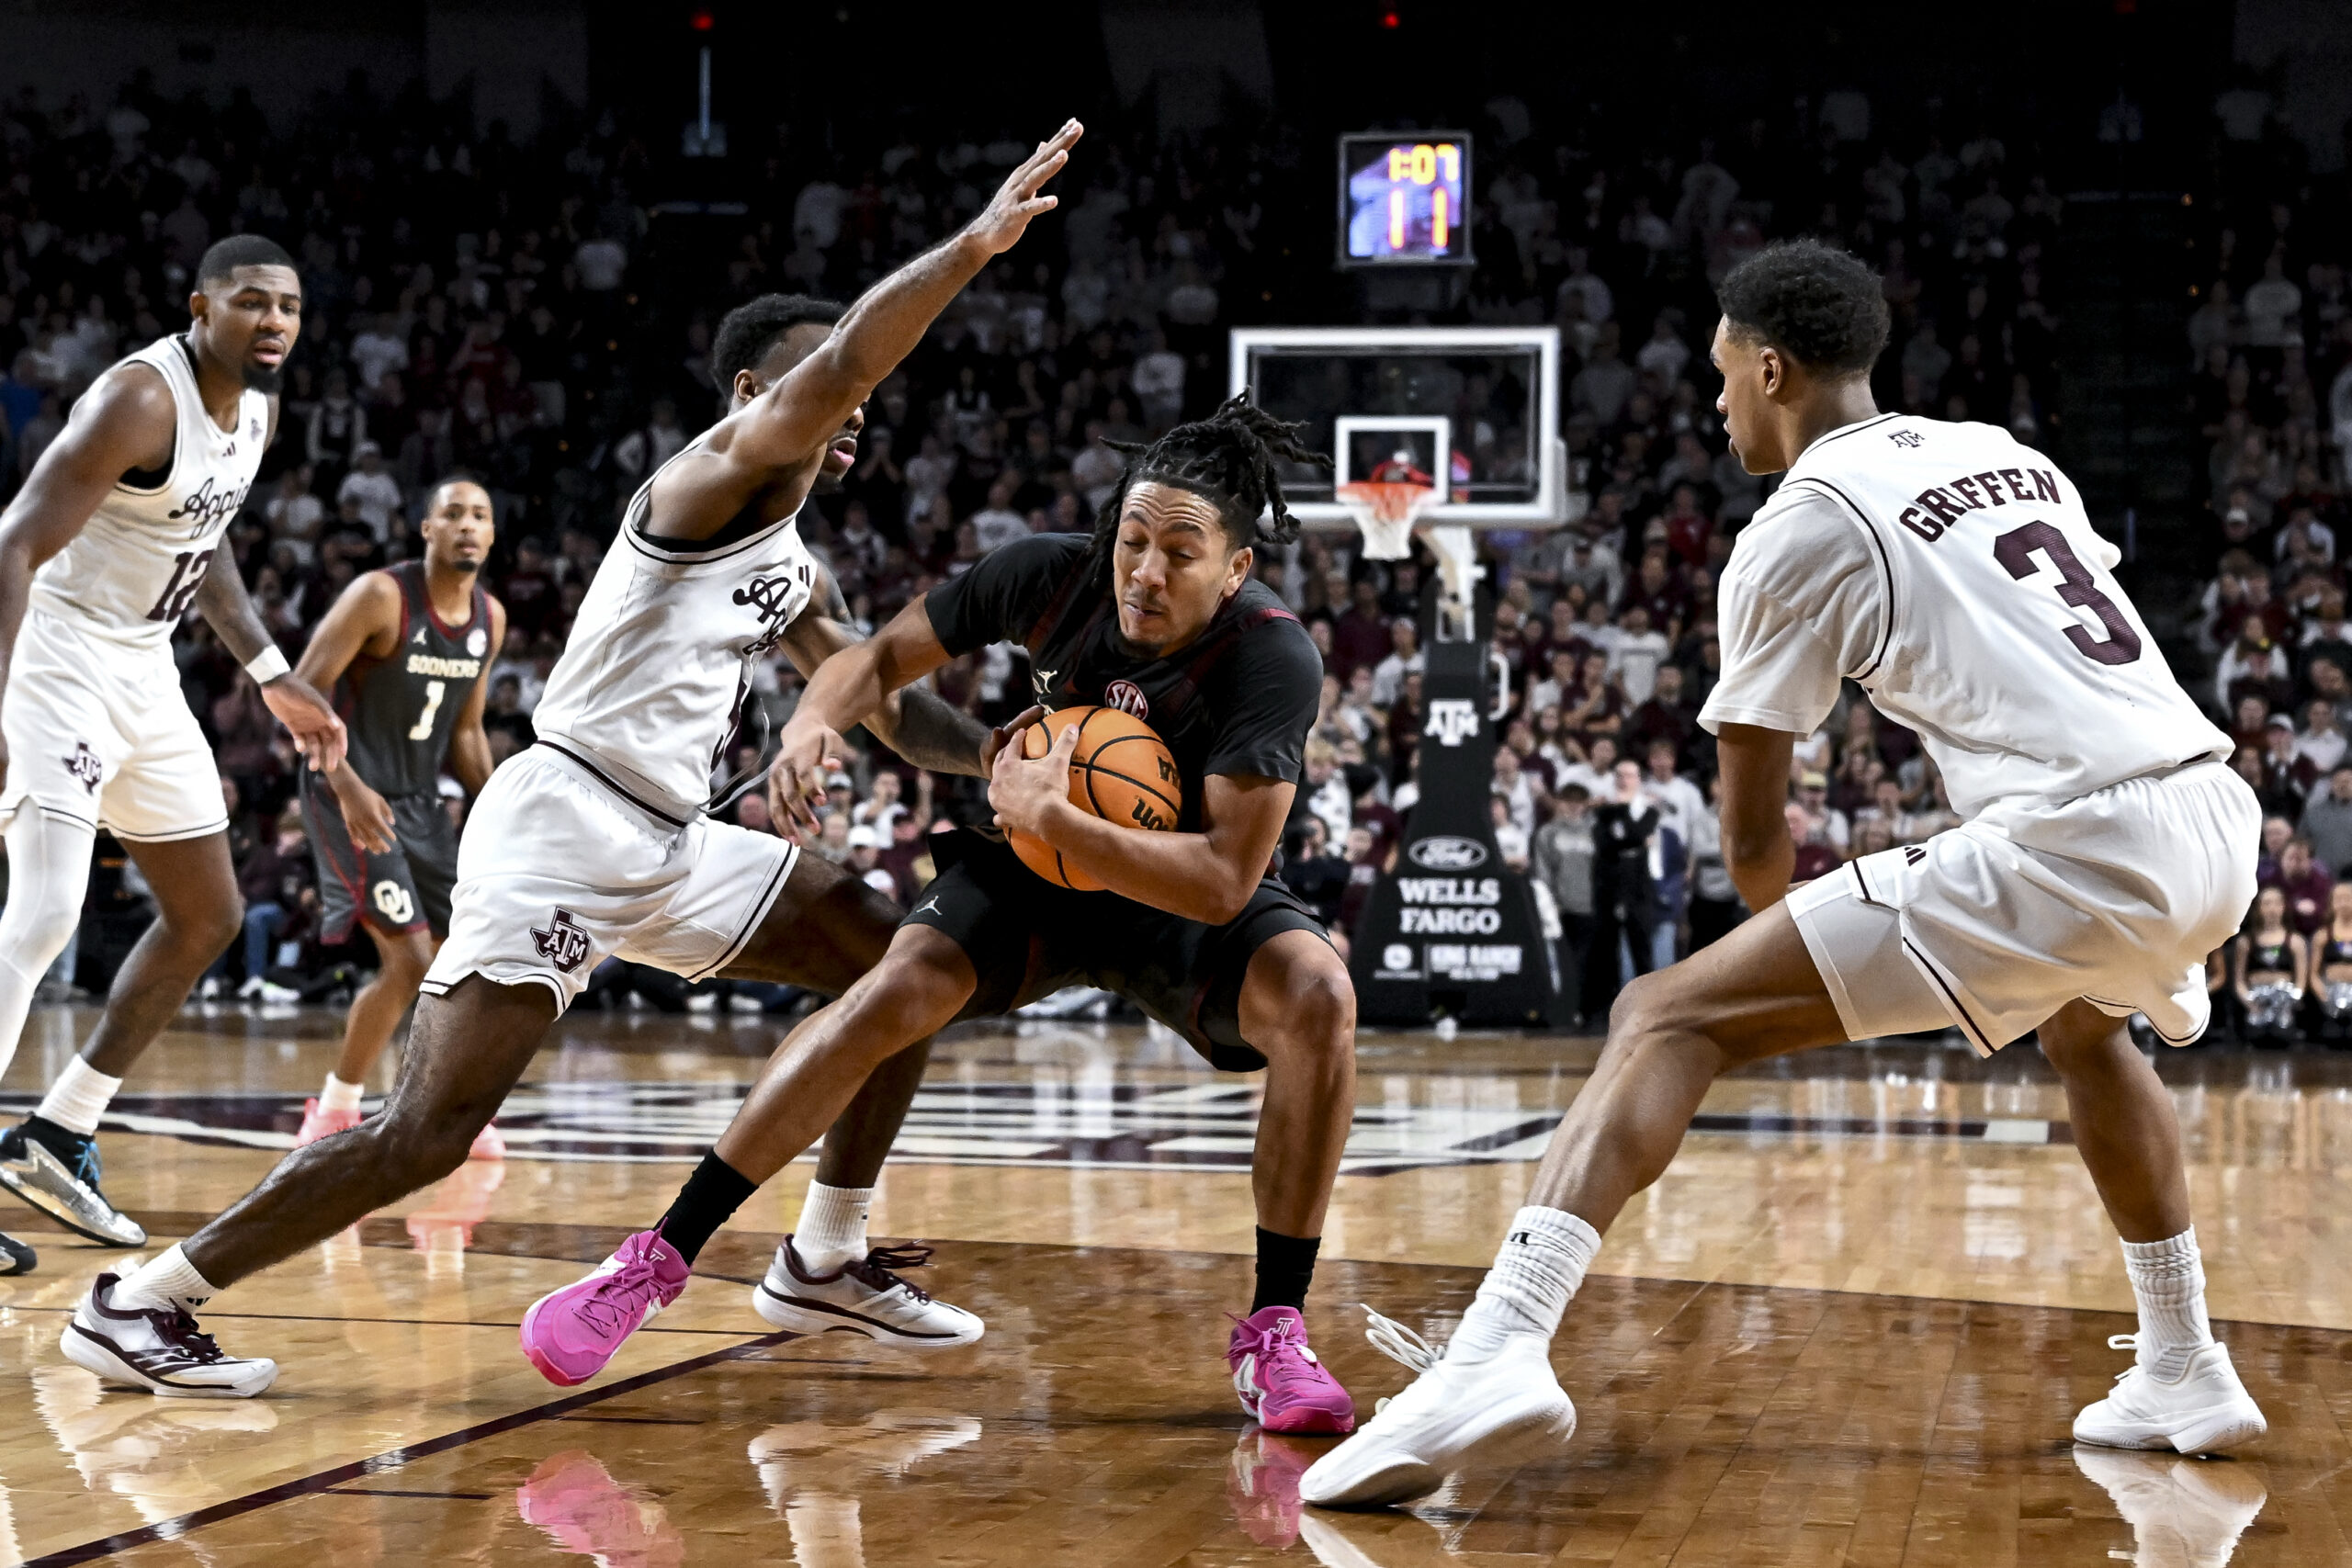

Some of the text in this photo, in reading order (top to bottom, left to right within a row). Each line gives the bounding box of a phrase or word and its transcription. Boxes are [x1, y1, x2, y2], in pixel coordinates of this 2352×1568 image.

[1898, 467, 2063, 543] GRIFFEN
[145, 549, 216, 622] 12
[1994, 520, 2142, 665] 3
[407, 654, 481, 678] SOONERS
[409, 681, 446, 740] 1
[373, 879, 414, 924] OU
[1398, 877, 1501, 905] WELLS
[1399, 907, 1501, 935] FARGO
